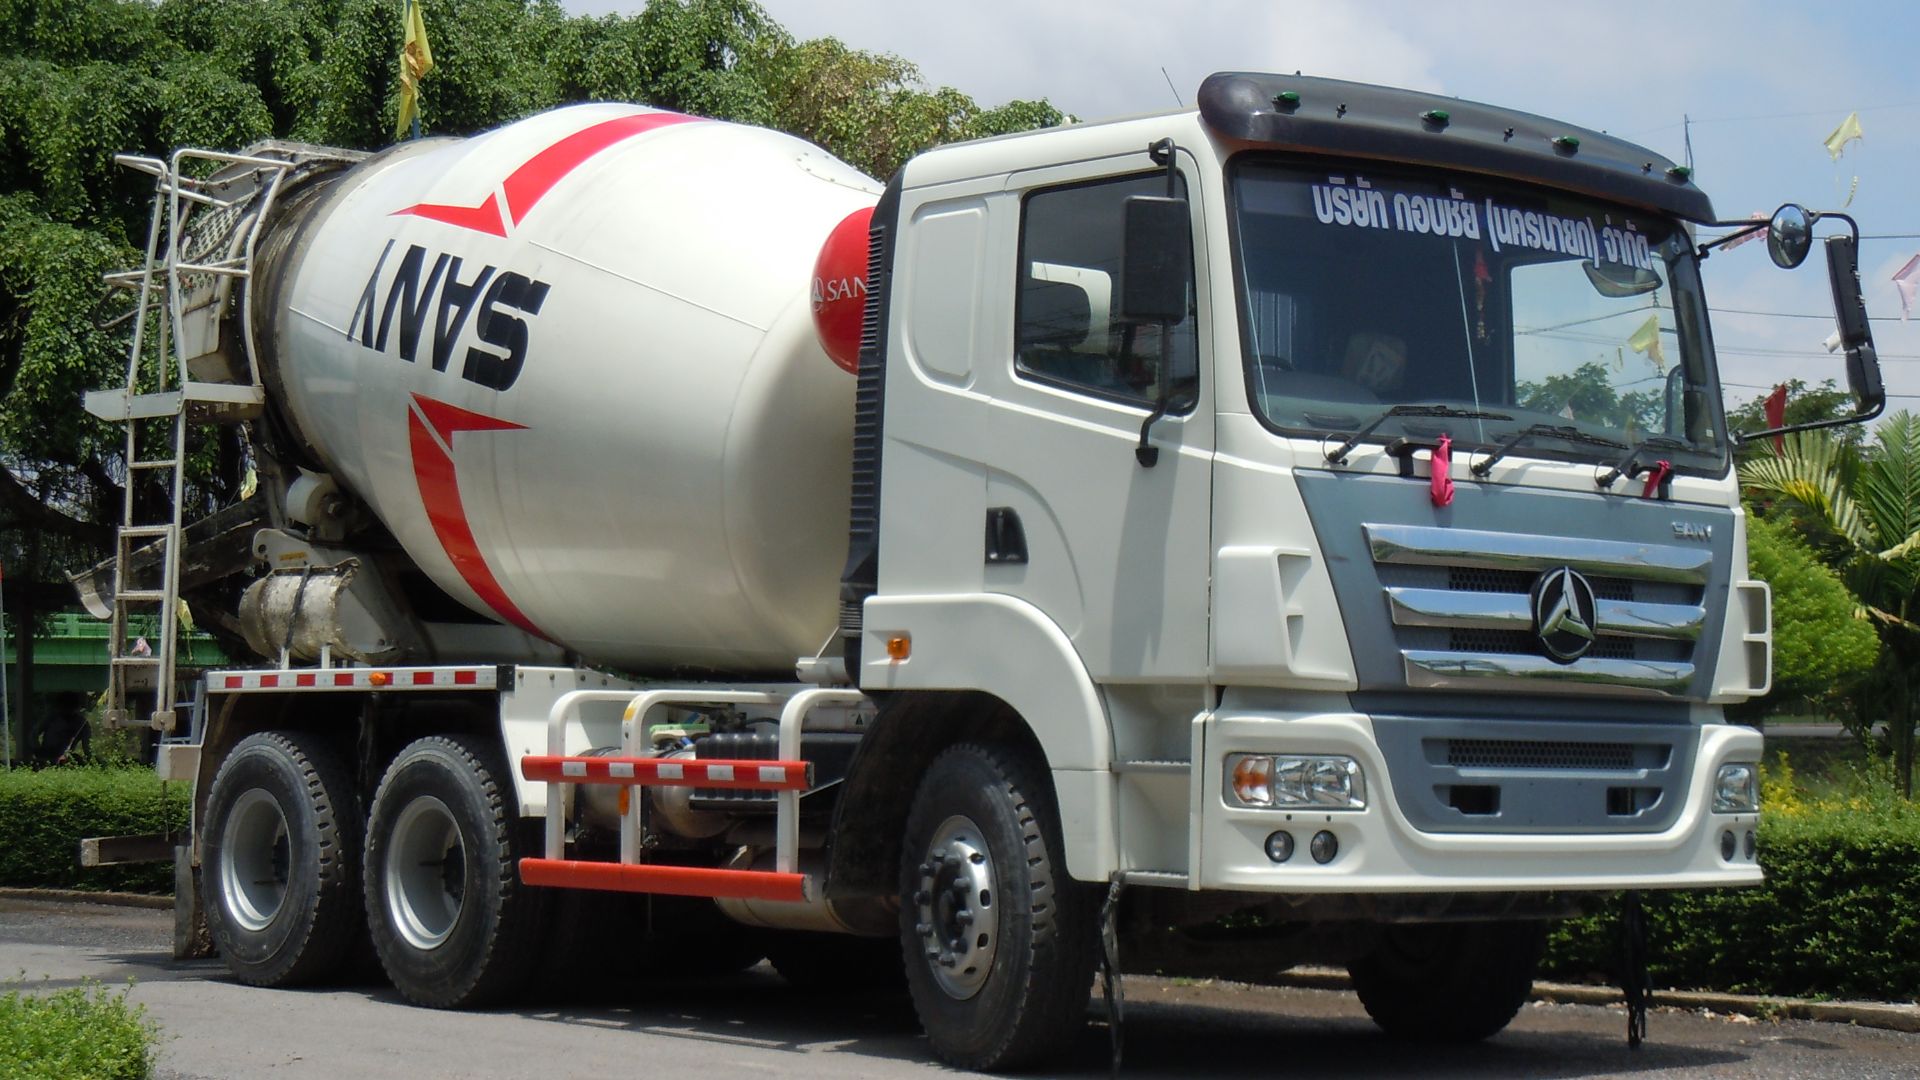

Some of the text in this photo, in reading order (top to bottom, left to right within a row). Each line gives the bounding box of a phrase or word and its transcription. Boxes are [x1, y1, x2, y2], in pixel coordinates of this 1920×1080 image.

[1312, 176, 1653, 270] บริษัท กอบชัย (นครนายก) จำกัด
[347, 238, 552, 392] SANY
